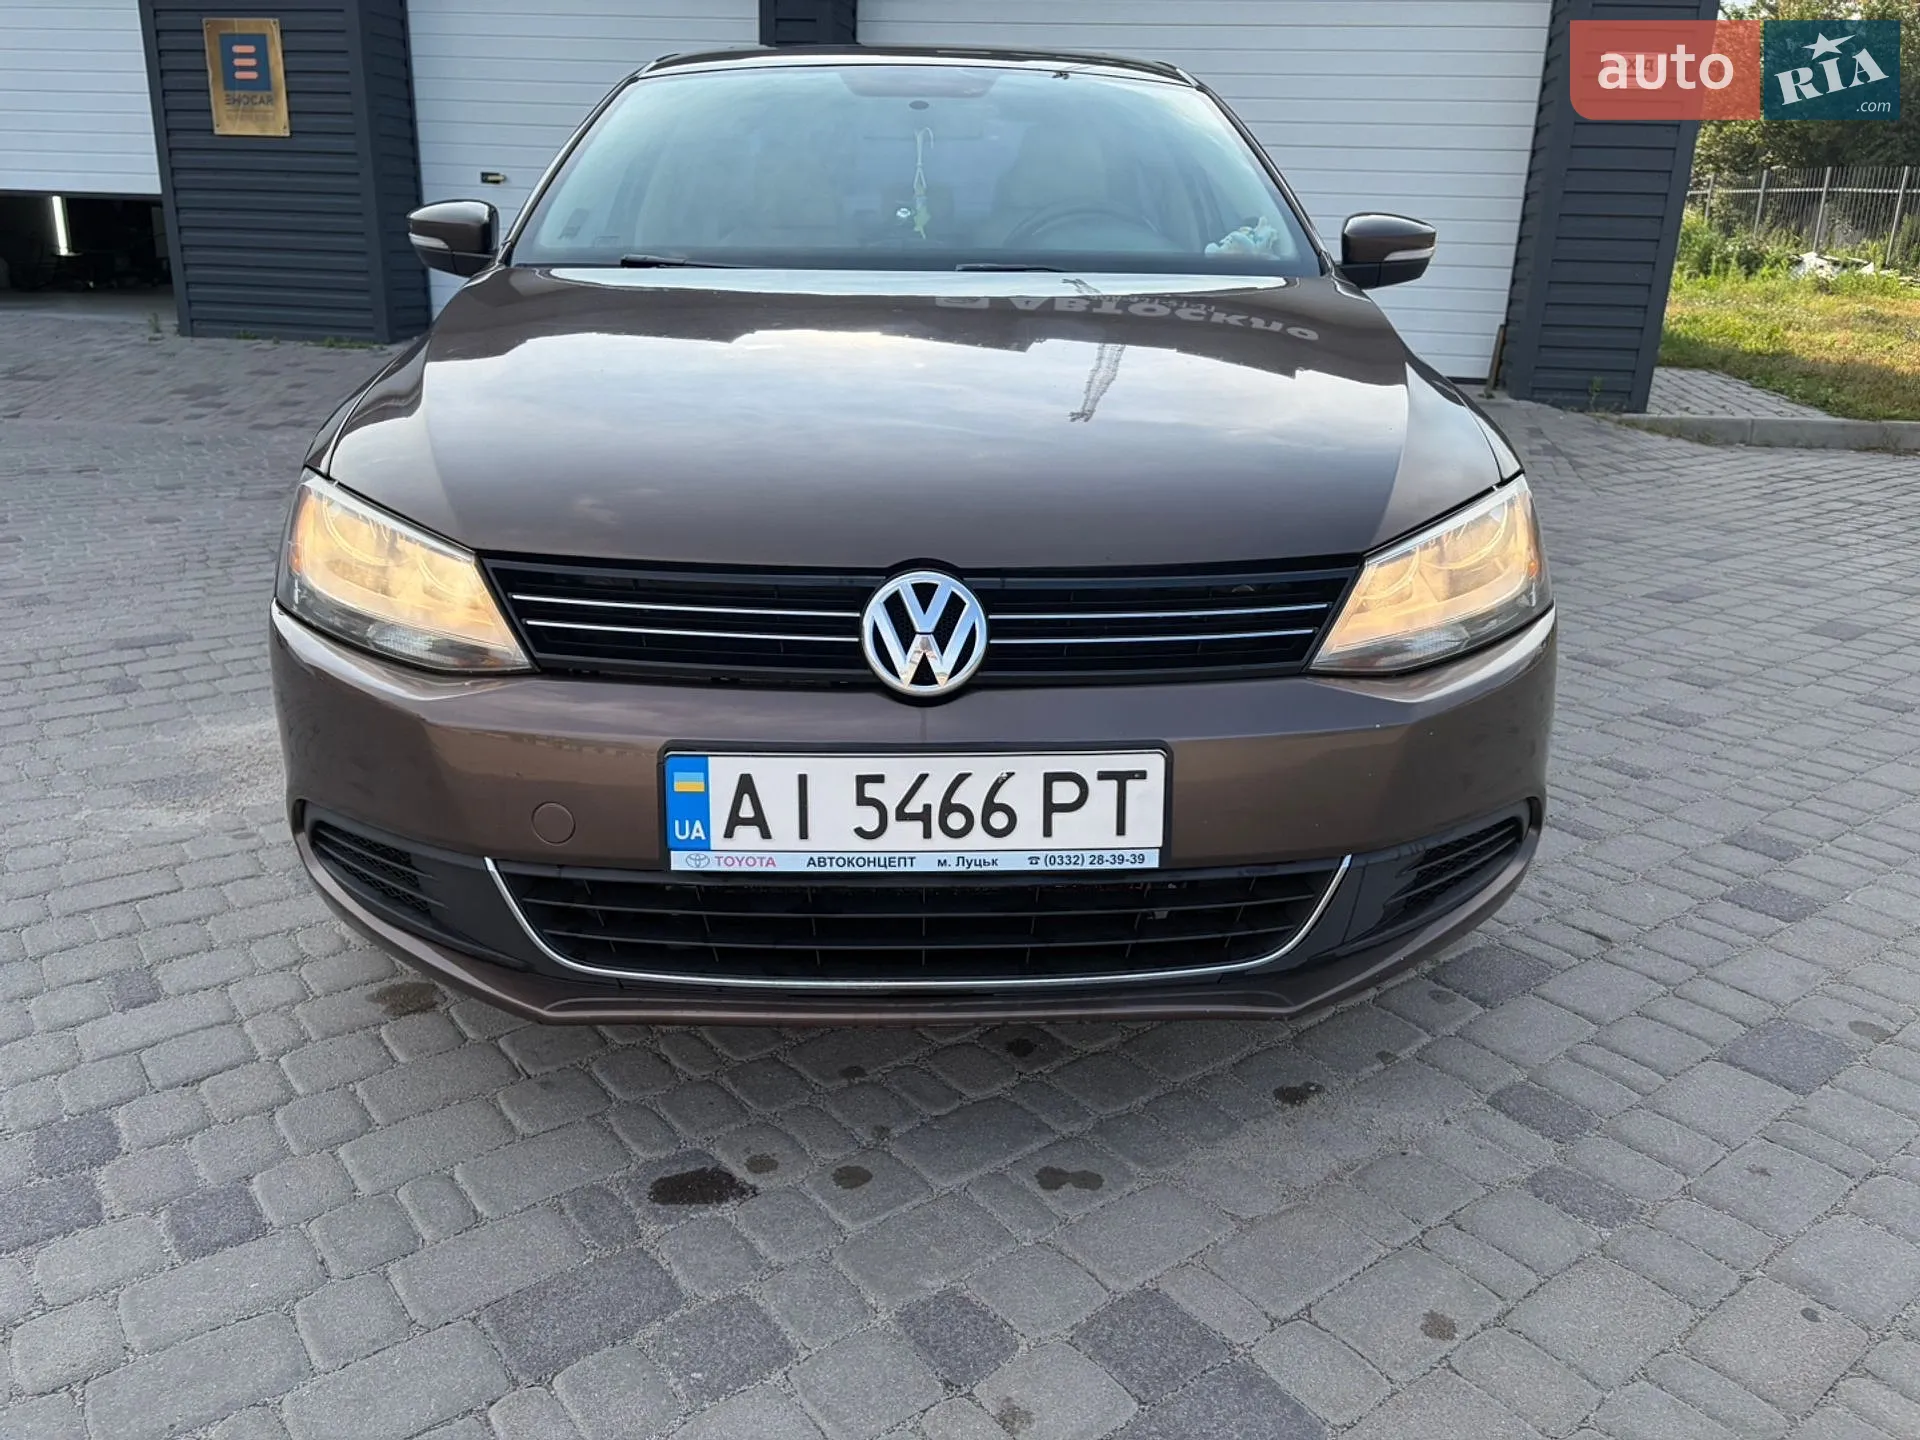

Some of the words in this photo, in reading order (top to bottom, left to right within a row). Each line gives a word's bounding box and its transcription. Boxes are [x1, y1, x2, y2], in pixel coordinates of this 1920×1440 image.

[854, 771, 1018, 840] 5466
[1042, 769, 1148, 838] PT
[674, 819, 707, 840] UA
[714, 856, 777, 868] TOYOTA
[806, 856, 917, 870] АВТОКОНЦЕПТ
[954, 856, 999, 869] Луцьк
[1043, 853, 1085, 867] (0332)
[1088, 853, 1146, 866] 28-39-39
